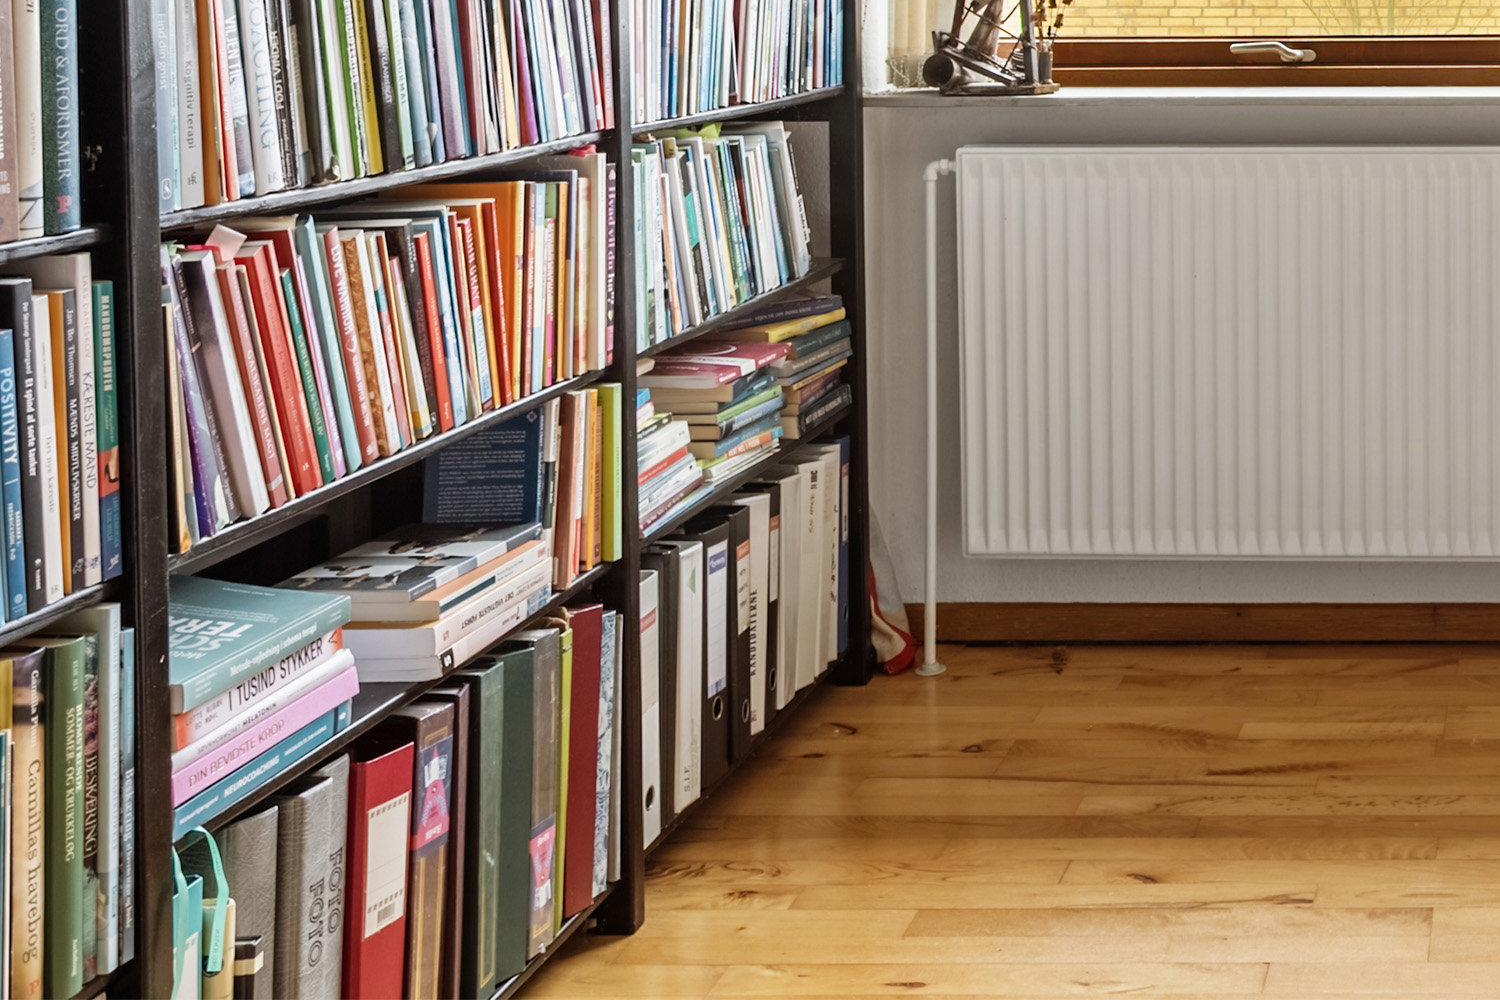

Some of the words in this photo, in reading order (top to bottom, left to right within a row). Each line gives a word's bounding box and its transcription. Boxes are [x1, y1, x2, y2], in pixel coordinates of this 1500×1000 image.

[54, 8, 69, 50] ORD
[56, 55, 68, 71] &
[270, 31, 282, 75] VINDER
[184, 59, 195, 110] Kognitiv
[56, 74, 72, 182] AFORISMER
[185, 113, 197, 150] terapi
[607, 186, 616, 226] Hvad
[331, 243, 346, 278] LOVE
[465, 227, 477, 264] JOHN
[607, 229, 616, 252] vil
[607, 254, 616, 271] du
[335, 276, 355, 336] WARRIOR
[468, 265, 481, 303] GRAY
[65, 308, 75, 325] Jan
[66, 328, 75, 342] Bo
[67, 345, 77, 386] Thomsen
[101, 294, 113, 392] MANDDOMSPRØVEN
[23, 389, 35, 410] spind
[24, 378, 34, 387] Et
[82, 371, 95, 438] KÆRESTE
[246, 349, 268, 423] GALSKABENS
[263, 426, 276, 461] MAGT
[1, 367, 17, 464] POSITIVITY
[26, 411, 36, 424] af
[27, 425, 36, 447] sorte
[68, 398, 79, 438] MÆNDS
[27, 448, 38, 477] tanker
[70, 441, 81, 521] MIDTLIVSKRISER
[84, 441, 97, 489] MAND
[749, 588, 759, 678] KANDIDATERNE
[29, 669, 41, 715] Camilla
[236, 667, 276, 706] TUSIND
[280, 637, 324, 680] STYKKER
[65, 707, 75, 767] SOMMER-
[242, 702, 277, 727] MELATONIN
[74, 703, 84, 794] BLOMSTRENDE
[188, 769, 208, 788] DIN
[210, 739, 256, 775] BEVIDSTE
[257, 718, 286, 744] KROP
[65, 769, 75, 786] OG
[223, 754, 280, 798] NEUROCOACHING
[25, 759, 42, 862] Camillas
[65, 787, 75, 863] KRUKKELØG
[83, 755, 97, 853] BESKÆRING
[122, 767, 135, 841] Beskæring
[329, 846, 343, 935] FOTO
[22, 867, 41, 965] havebog
[307, 877, 325, 968] FOTO
